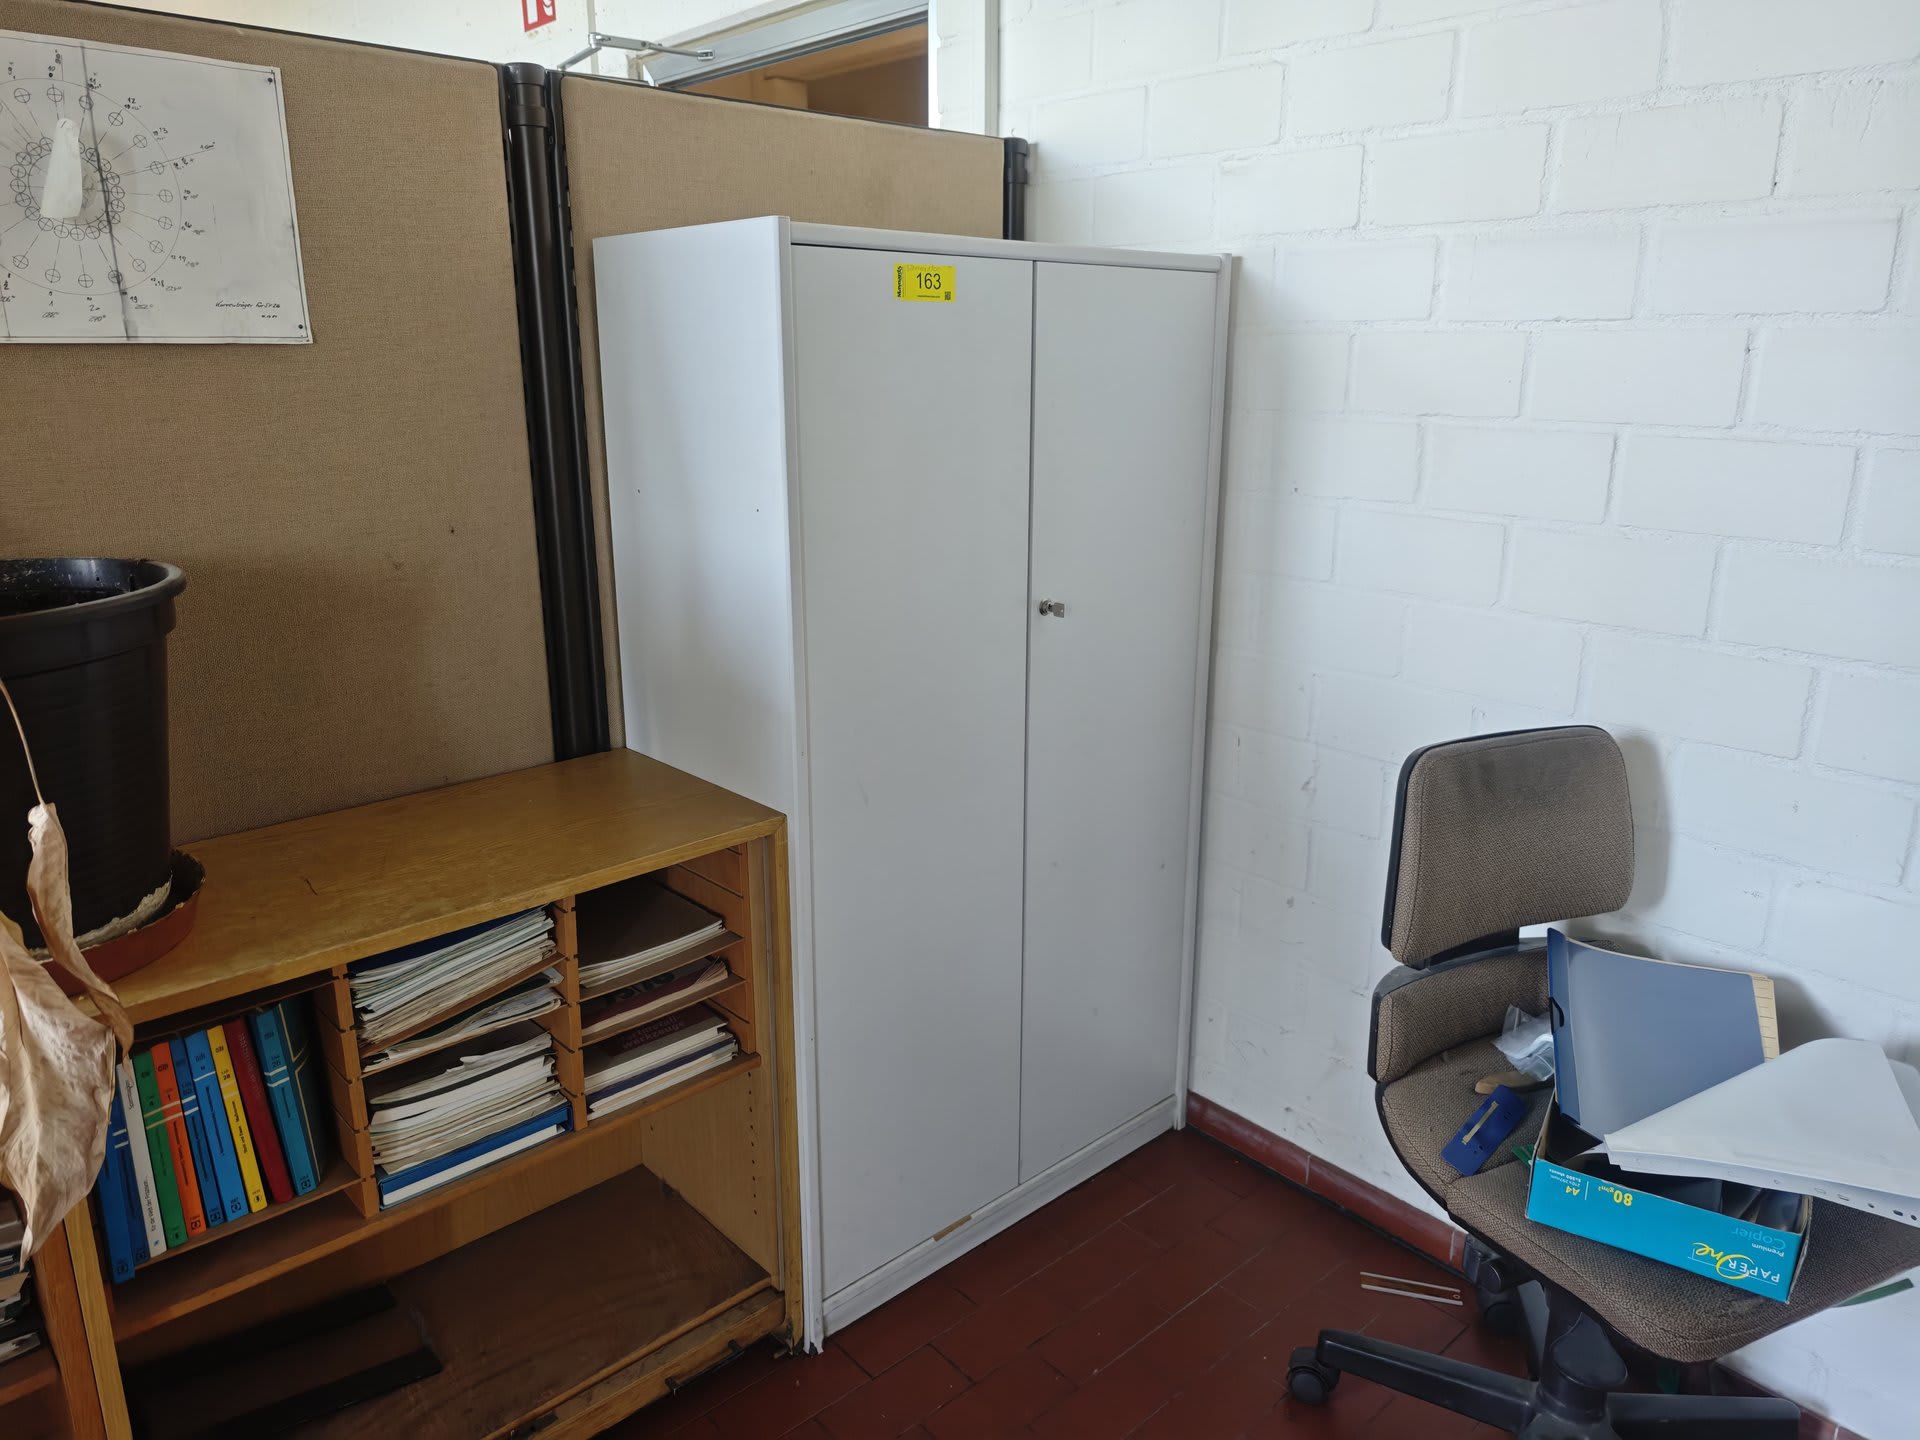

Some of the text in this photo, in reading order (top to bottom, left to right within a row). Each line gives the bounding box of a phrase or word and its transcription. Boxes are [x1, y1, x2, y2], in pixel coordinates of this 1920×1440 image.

[916, 272, 942, 290] 163
[1565, 1185, 1580, 1196] A4
[1613, 1189, 1633, 1207] 80
[1731, 1227, 1786, 1250] Copier
[1751, 1242, 1785, 1258] Premium
